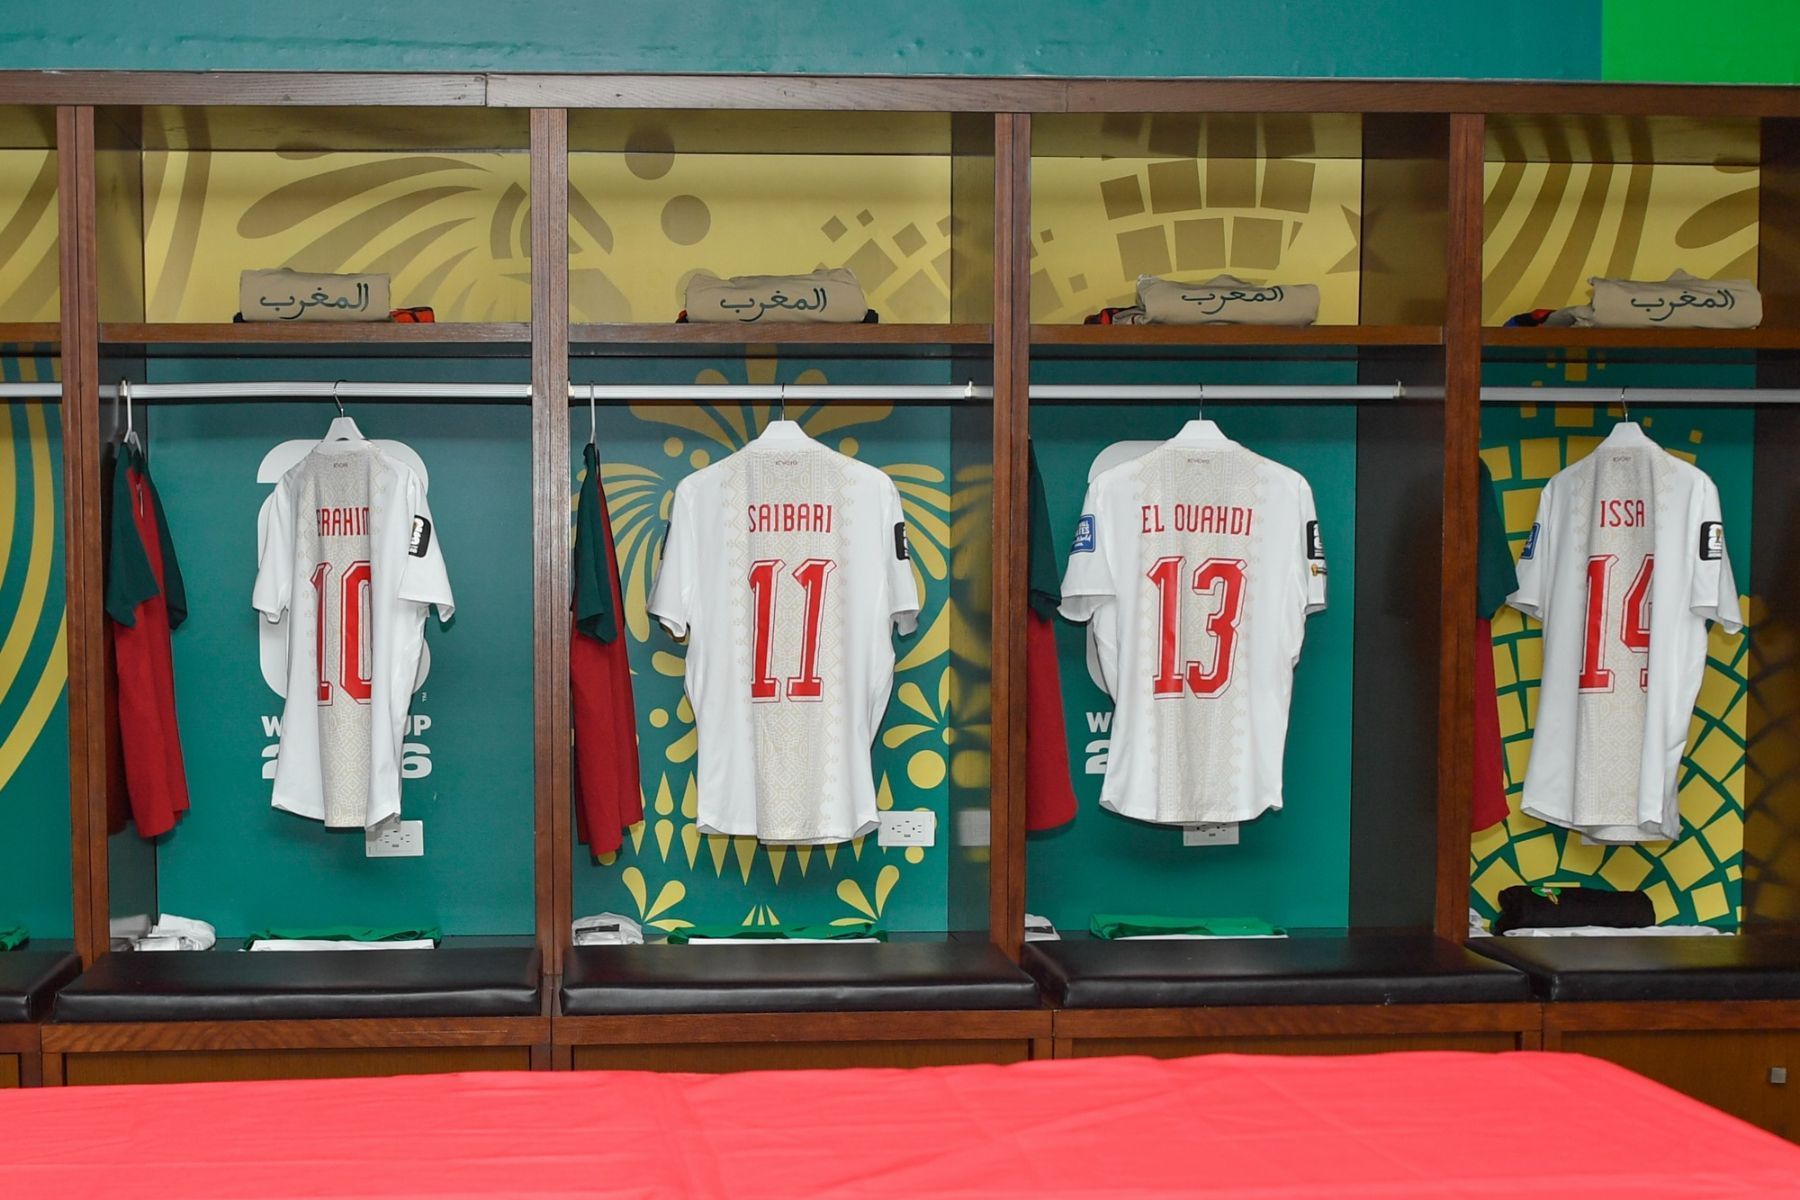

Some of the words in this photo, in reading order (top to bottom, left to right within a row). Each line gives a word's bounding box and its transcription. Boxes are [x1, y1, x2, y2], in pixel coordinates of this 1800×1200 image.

[260, 282, 369, 320] المغرب
[720, 287, 827, 322] المغرب
[1630, 289, 1735, 322] المغرب
[747, 503, 832, 533] SAIBARI
[1141, 504, 1165, 534] EL
[1174, 503, 1253, 536] OUAHDI
[1600, 499, 1645, 528] ISSA
[747, 558, 837, 704] 11
[1146, 556, 1248, 700] 13
